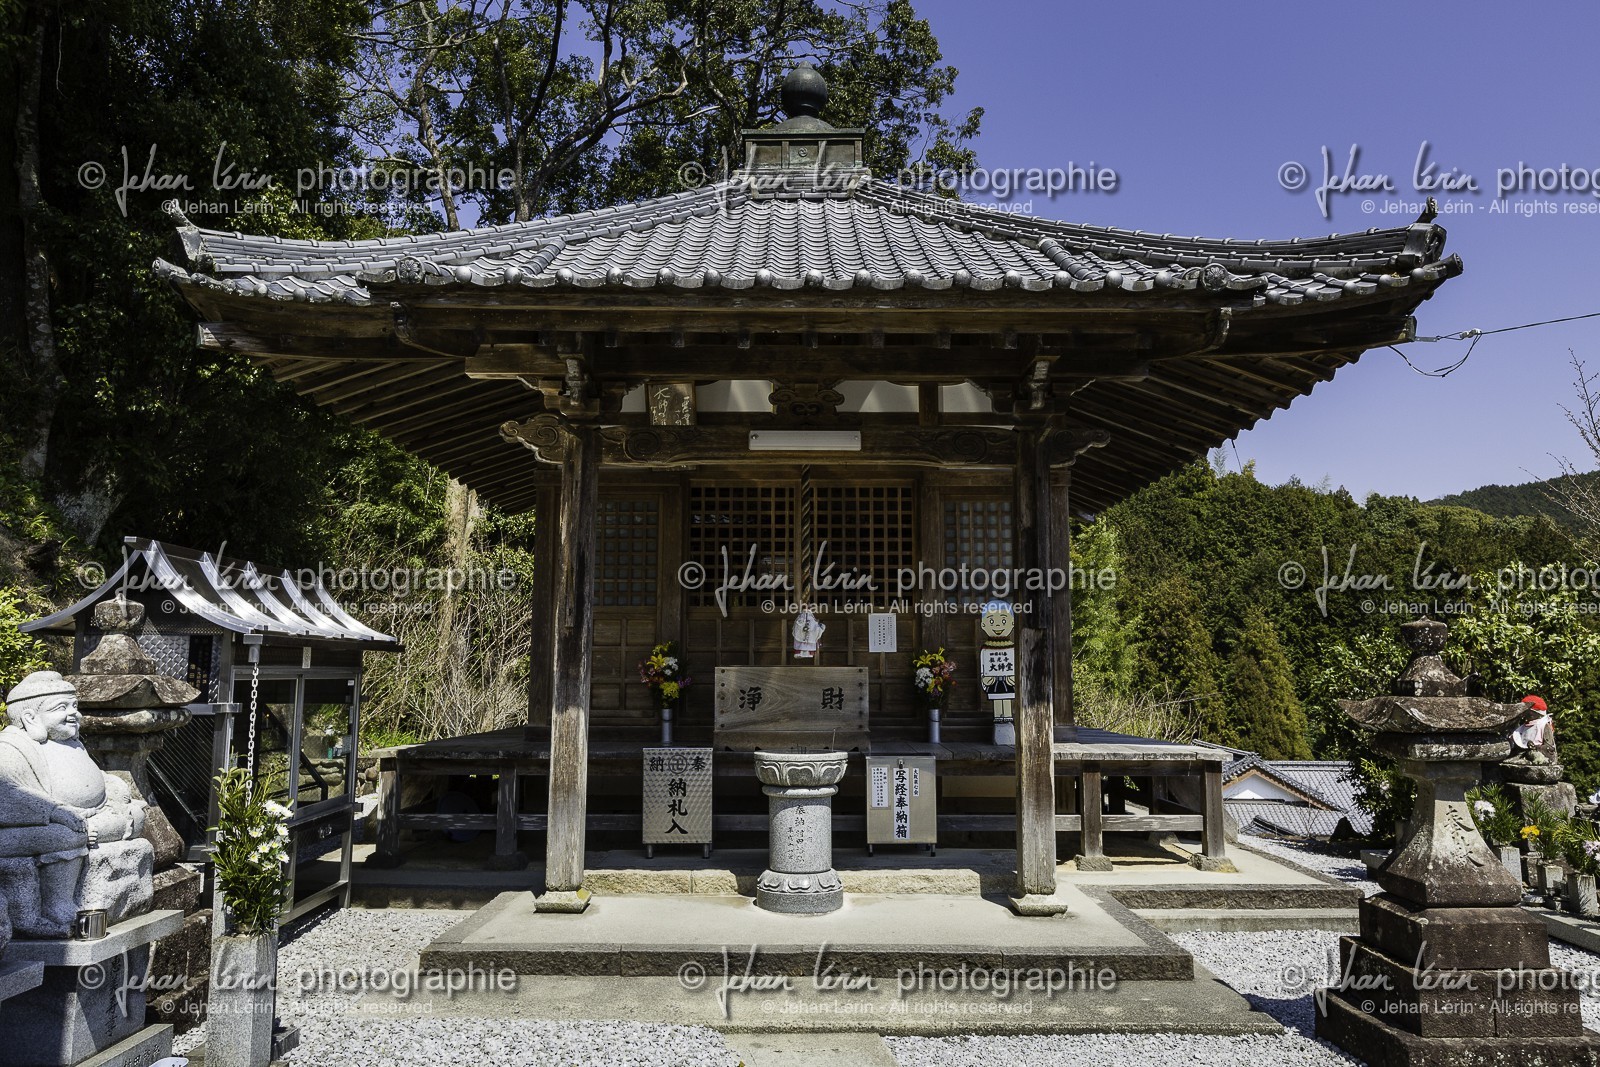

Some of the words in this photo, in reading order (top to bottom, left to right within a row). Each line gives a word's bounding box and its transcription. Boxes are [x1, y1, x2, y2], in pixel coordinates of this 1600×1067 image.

[988, 662, 1014, 673] 大師堂
[664, 778, 689, 835] 納札入
[895, 769, 909, 839] 写経奉納箱
